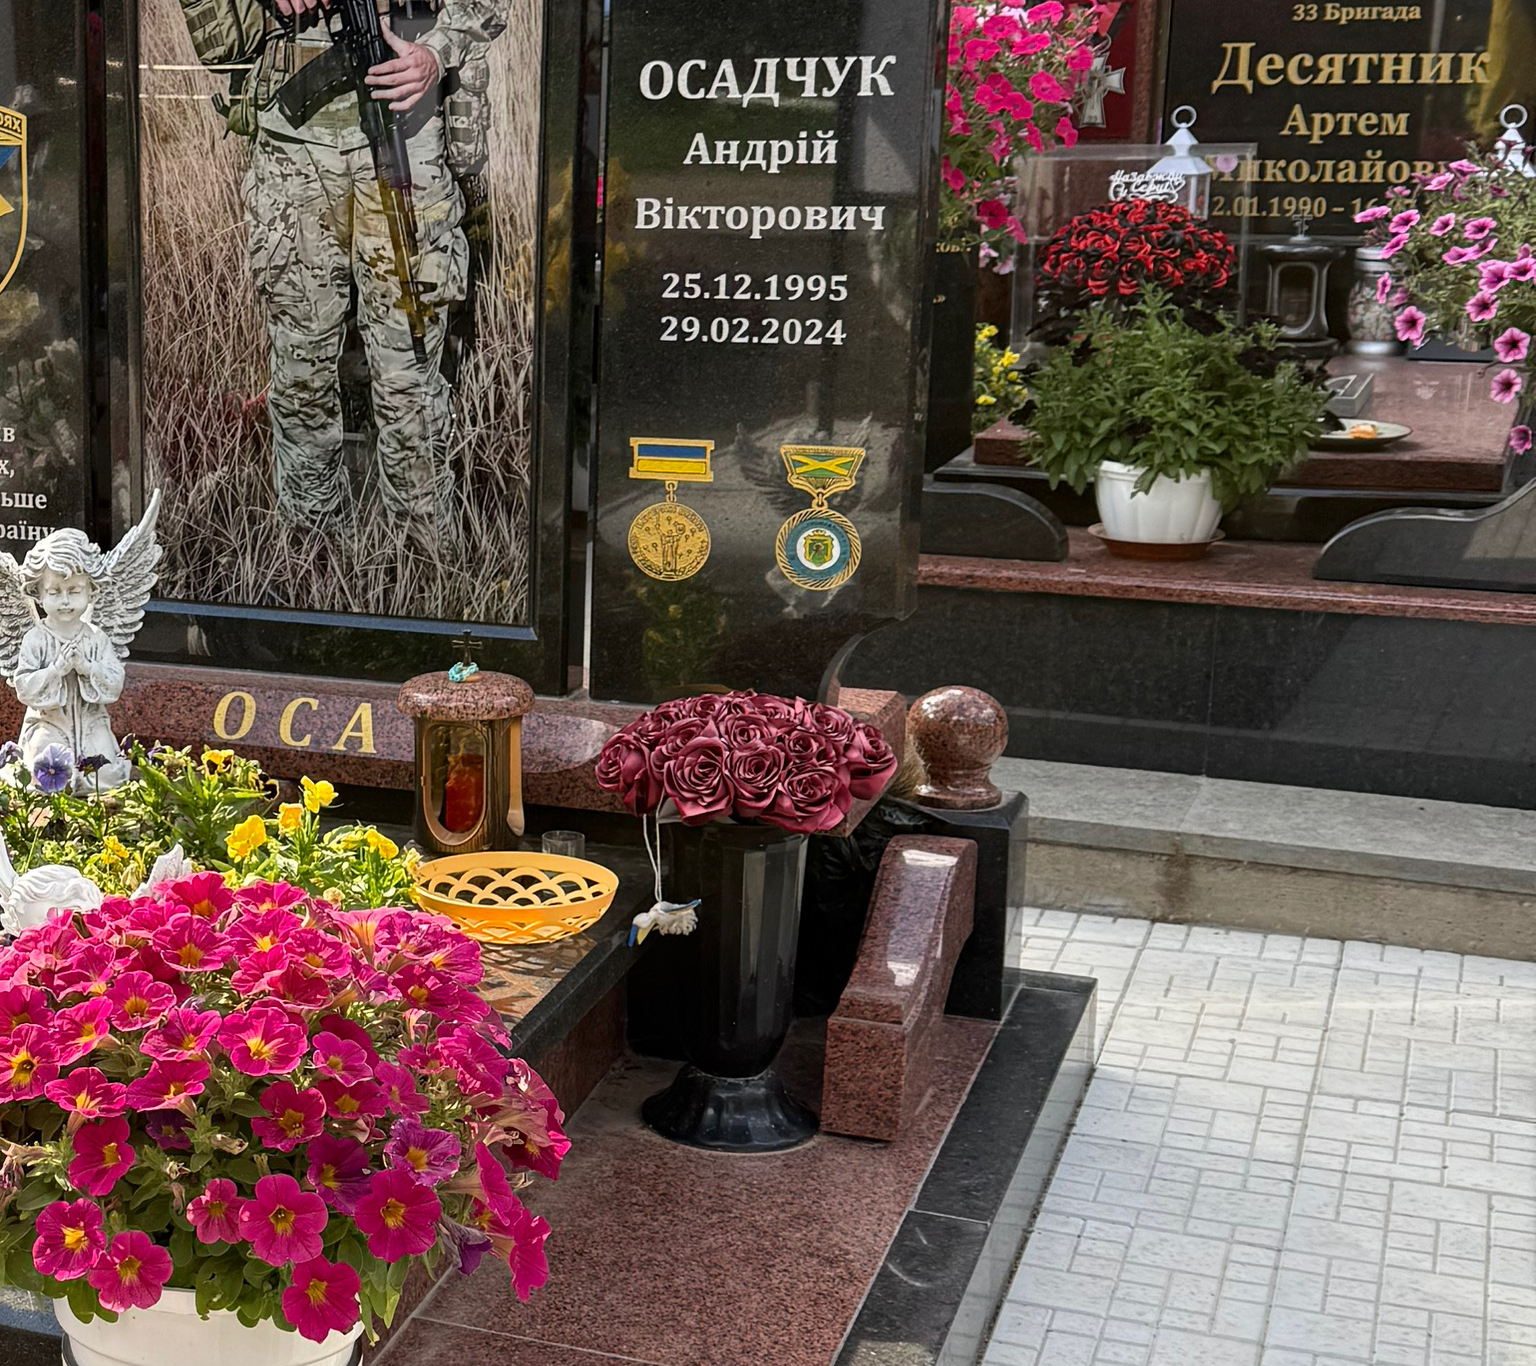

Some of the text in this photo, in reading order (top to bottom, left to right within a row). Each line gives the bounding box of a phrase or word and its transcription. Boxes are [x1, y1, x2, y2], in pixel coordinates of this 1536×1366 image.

[1292, 3, 1421, 25] 33 Бригада
[638, 55, 897, 108] ОСАДЧУК
[1211, 42, 1491, 95] Десятник
[1279, 103, 1410, 145] Артем
[683, 131, 839, 172] Андрій
[635, 197, 886, 238] Вікторович
[662, 273, 848, 302] 25.12.1995
[659, 316, 847, 346] 29.02.2024
